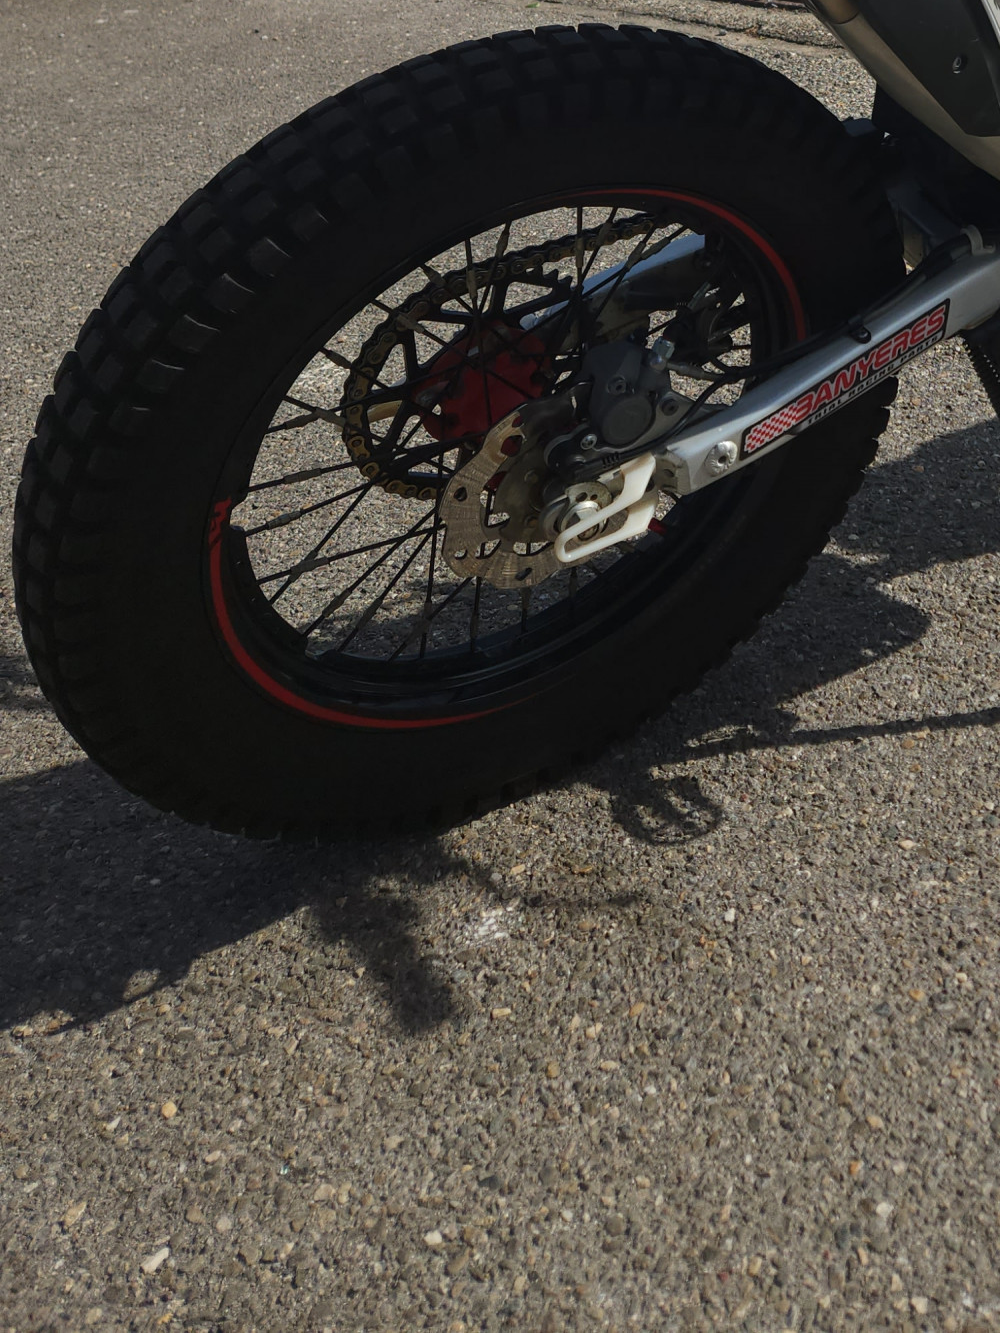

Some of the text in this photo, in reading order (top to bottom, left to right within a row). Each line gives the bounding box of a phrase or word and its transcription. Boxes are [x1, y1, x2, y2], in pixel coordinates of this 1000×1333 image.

[795, 306, 946, 422] BANYERES
[808, 335, 939, 425] TRIAL RACING PARTS
